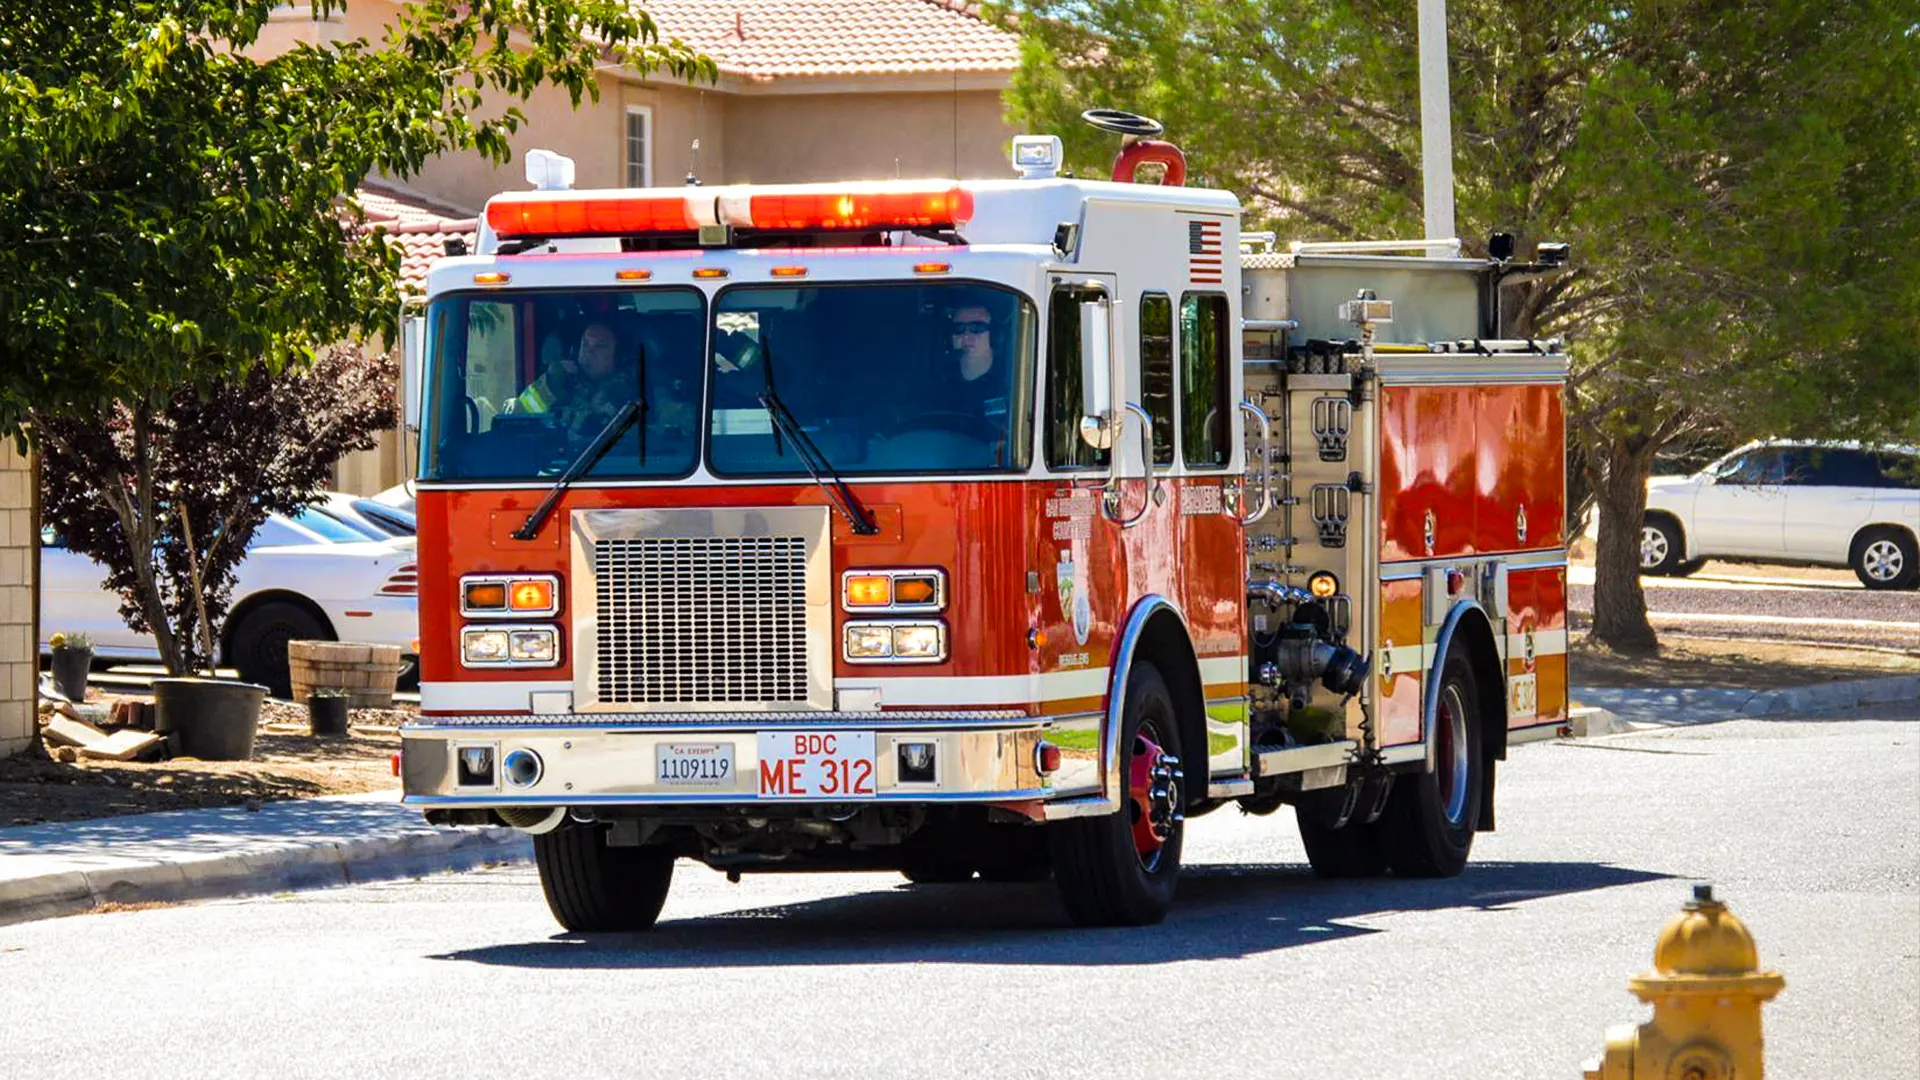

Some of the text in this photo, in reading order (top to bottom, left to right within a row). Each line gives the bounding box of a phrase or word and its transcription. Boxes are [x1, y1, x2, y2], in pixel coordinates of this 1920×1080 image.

[674, 747, 685, 755] CA
[794, 734, 838, 755] BDC
[661, 758, 730, 779] 1109119
[759, 758, 874, 795] ME 312
